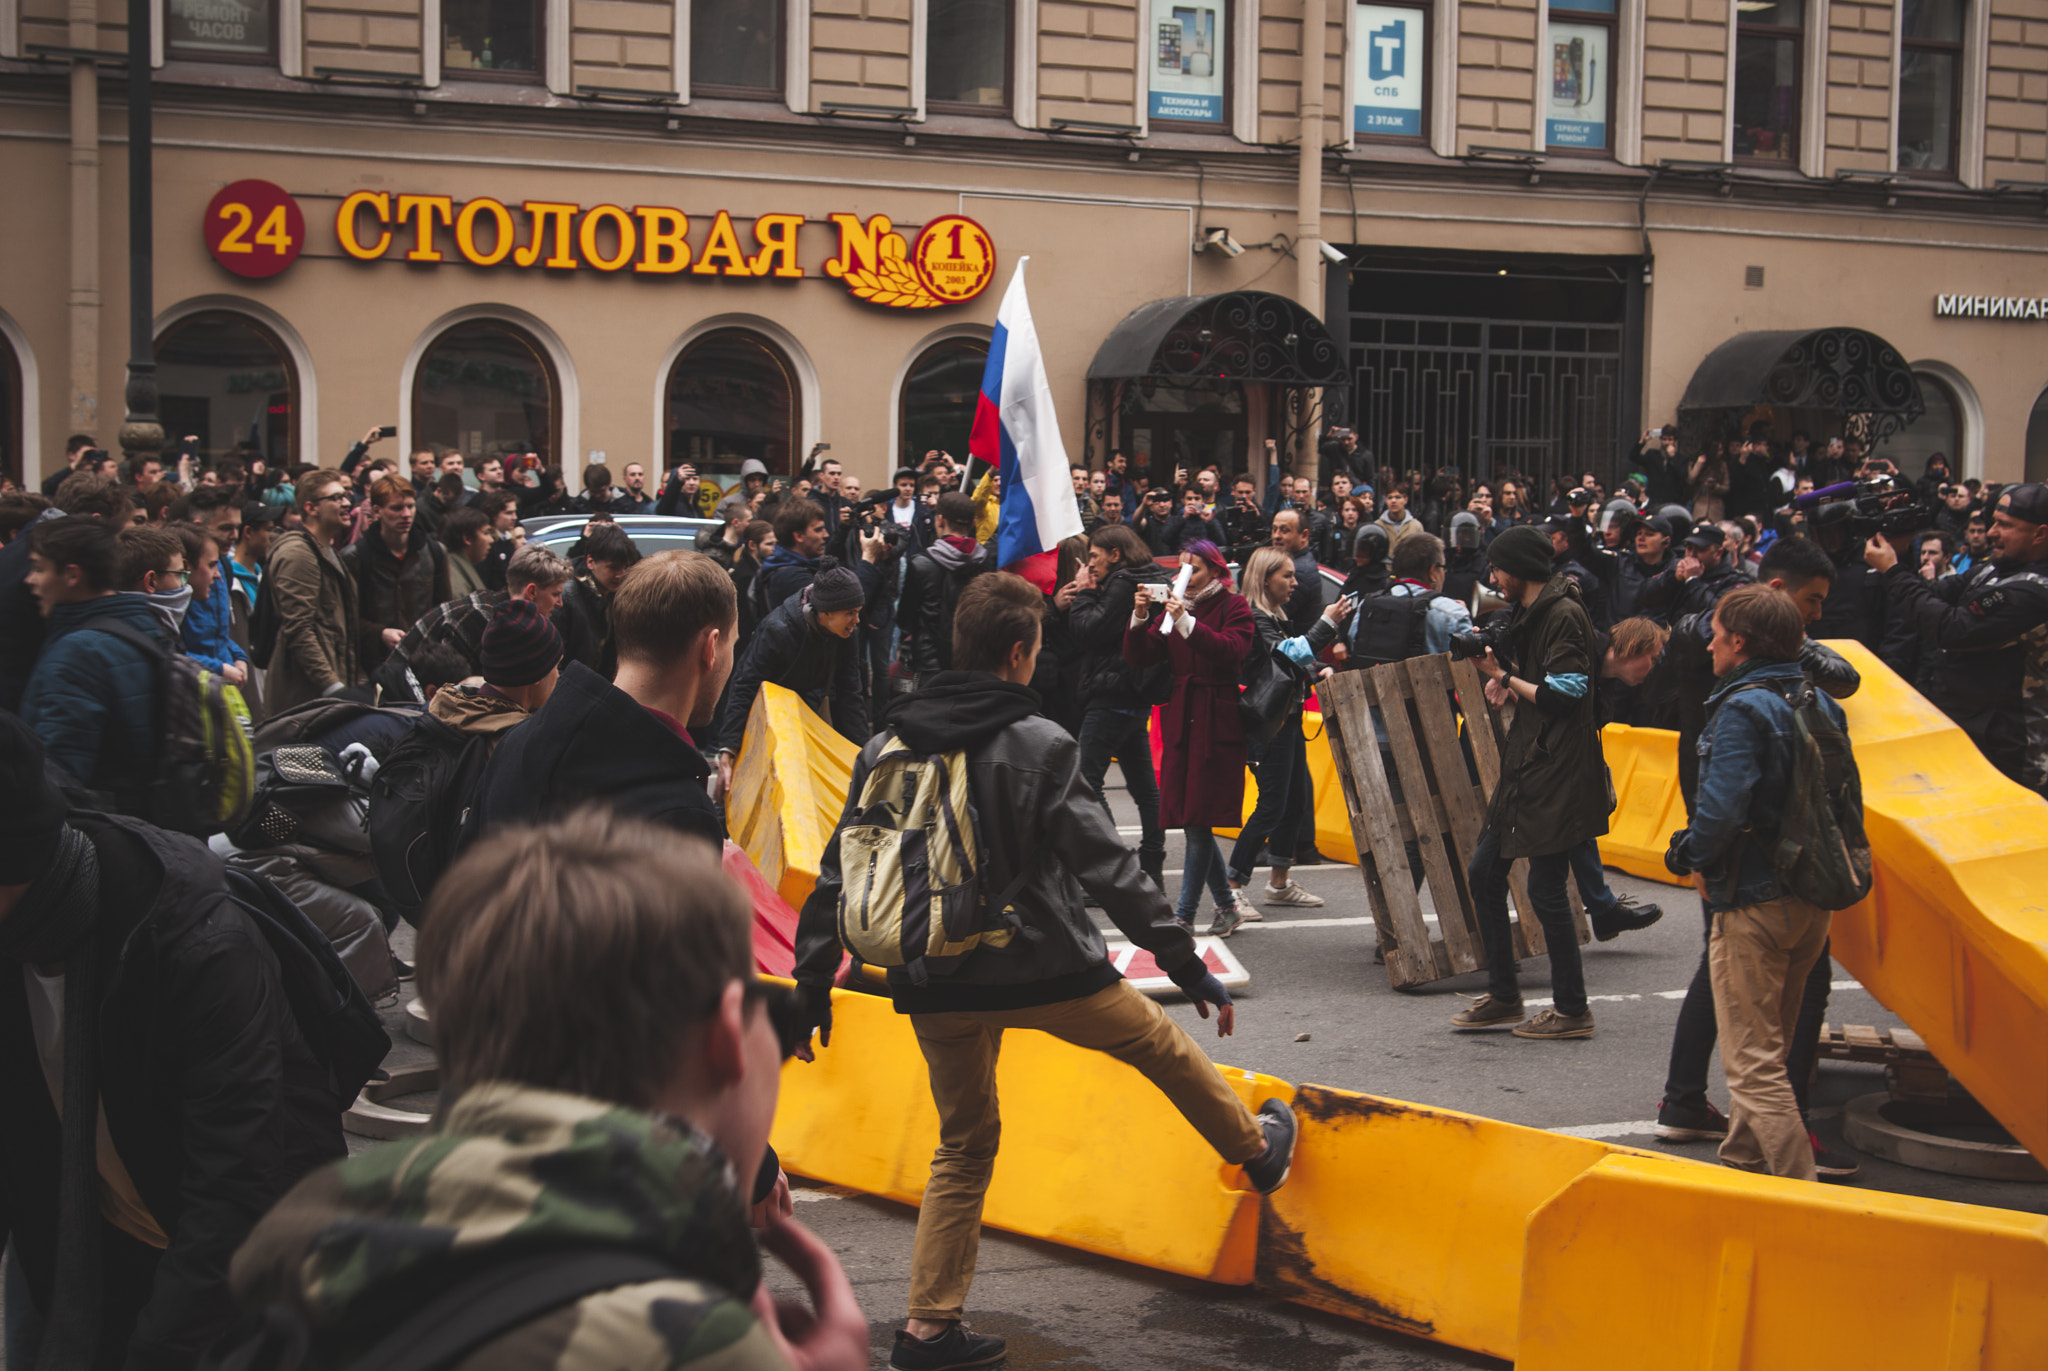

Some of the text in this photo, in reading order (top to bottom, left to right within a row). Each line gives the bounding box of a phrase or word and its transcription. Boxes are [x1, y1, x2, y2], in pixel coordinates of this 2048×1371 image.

[183, 4, 251, 22] РЕМОНТ
[189, 21, 245, 40] ЧАСОВ
[1373, 86, 1399, 97] СПБ
[1161, 96, 1209, 107] ТЕХНИКА И
[1157, 106, 1212, 117] АКСЕССУАРЫ
[1367, 115, 1404, 126] 2 ЭТАЖ
[1554, 124, 1590, 134] СЕРВИС И
[1556, 133, 1587, 143] РЕМОНТ
[218, 202, 293, 256] 24
[335, 189, 805, 278] СТОЛОВАЯ
[946, 224, 965, 260] 1
[931, 262, 980, 273] КОПЕЙКА
[945, 275, 967, 285] 2003
